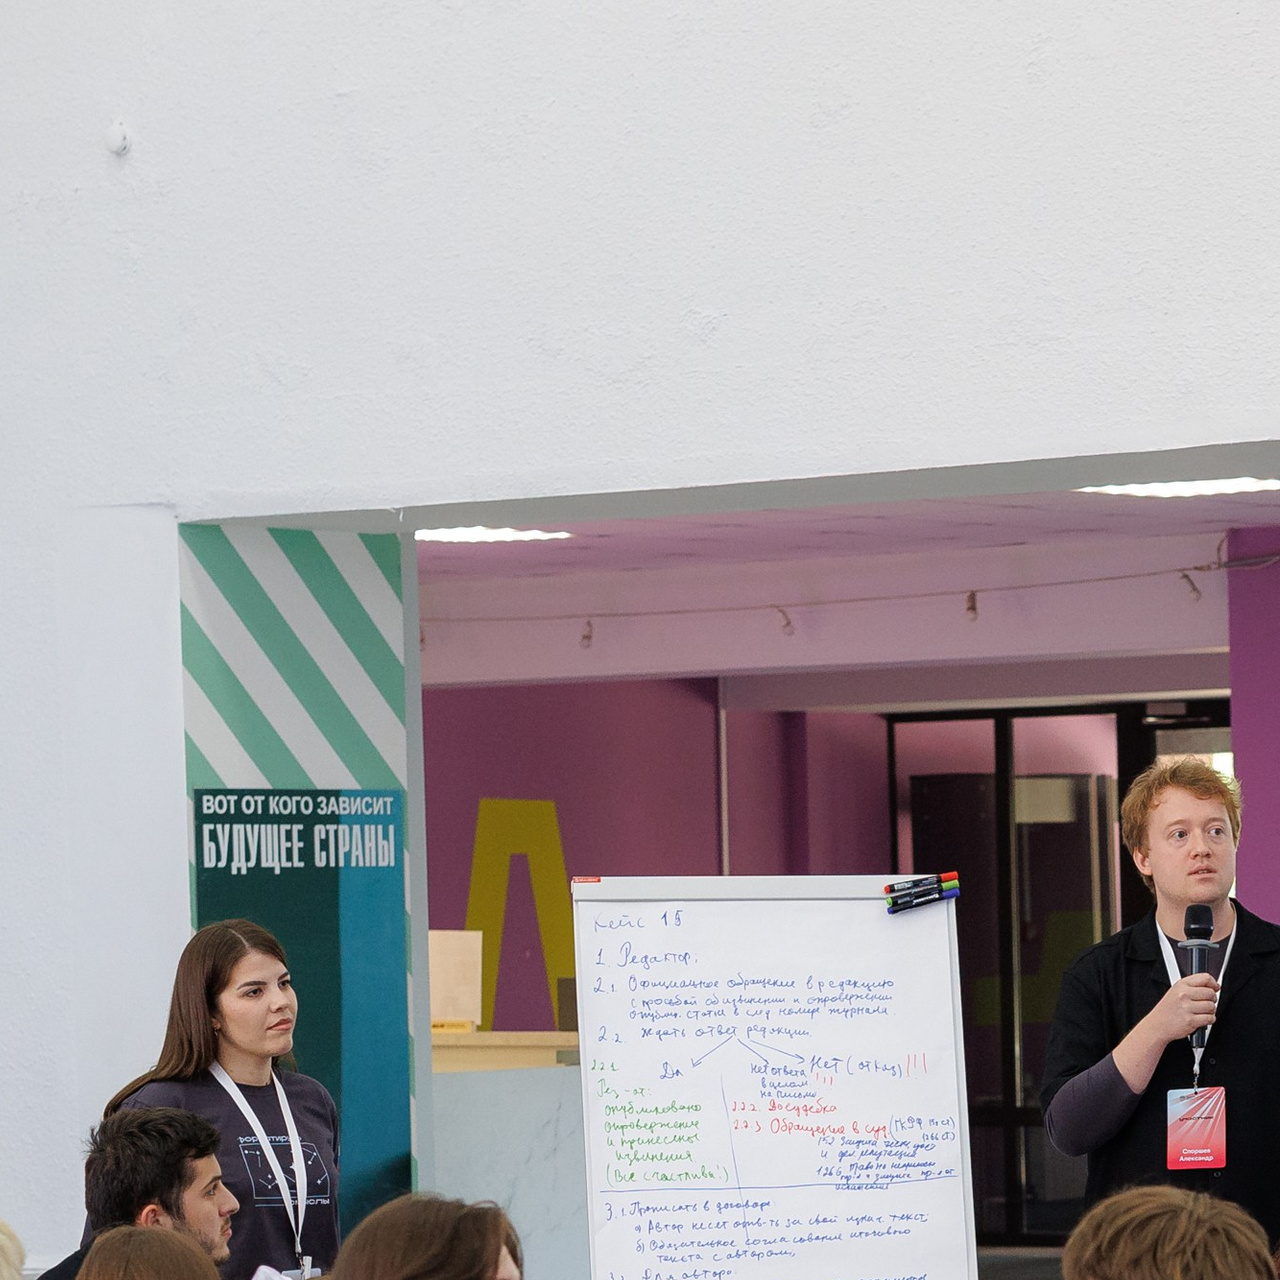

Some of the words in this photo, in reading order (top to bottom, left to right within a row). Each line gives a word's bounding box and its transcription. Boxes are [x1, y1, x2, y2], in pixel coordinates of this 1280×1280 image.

[202, 795, 238, 814] ВОТ
[241, 795, 265, 815] ОТ
[269, 795, 313, 815] КОГО
[317, 796, 394, 815] ЗАВИСИТ
[202, 823, 305, 875] БУДУЩЕЕ
[314, 823, 395, 867] СТРАНЫ
